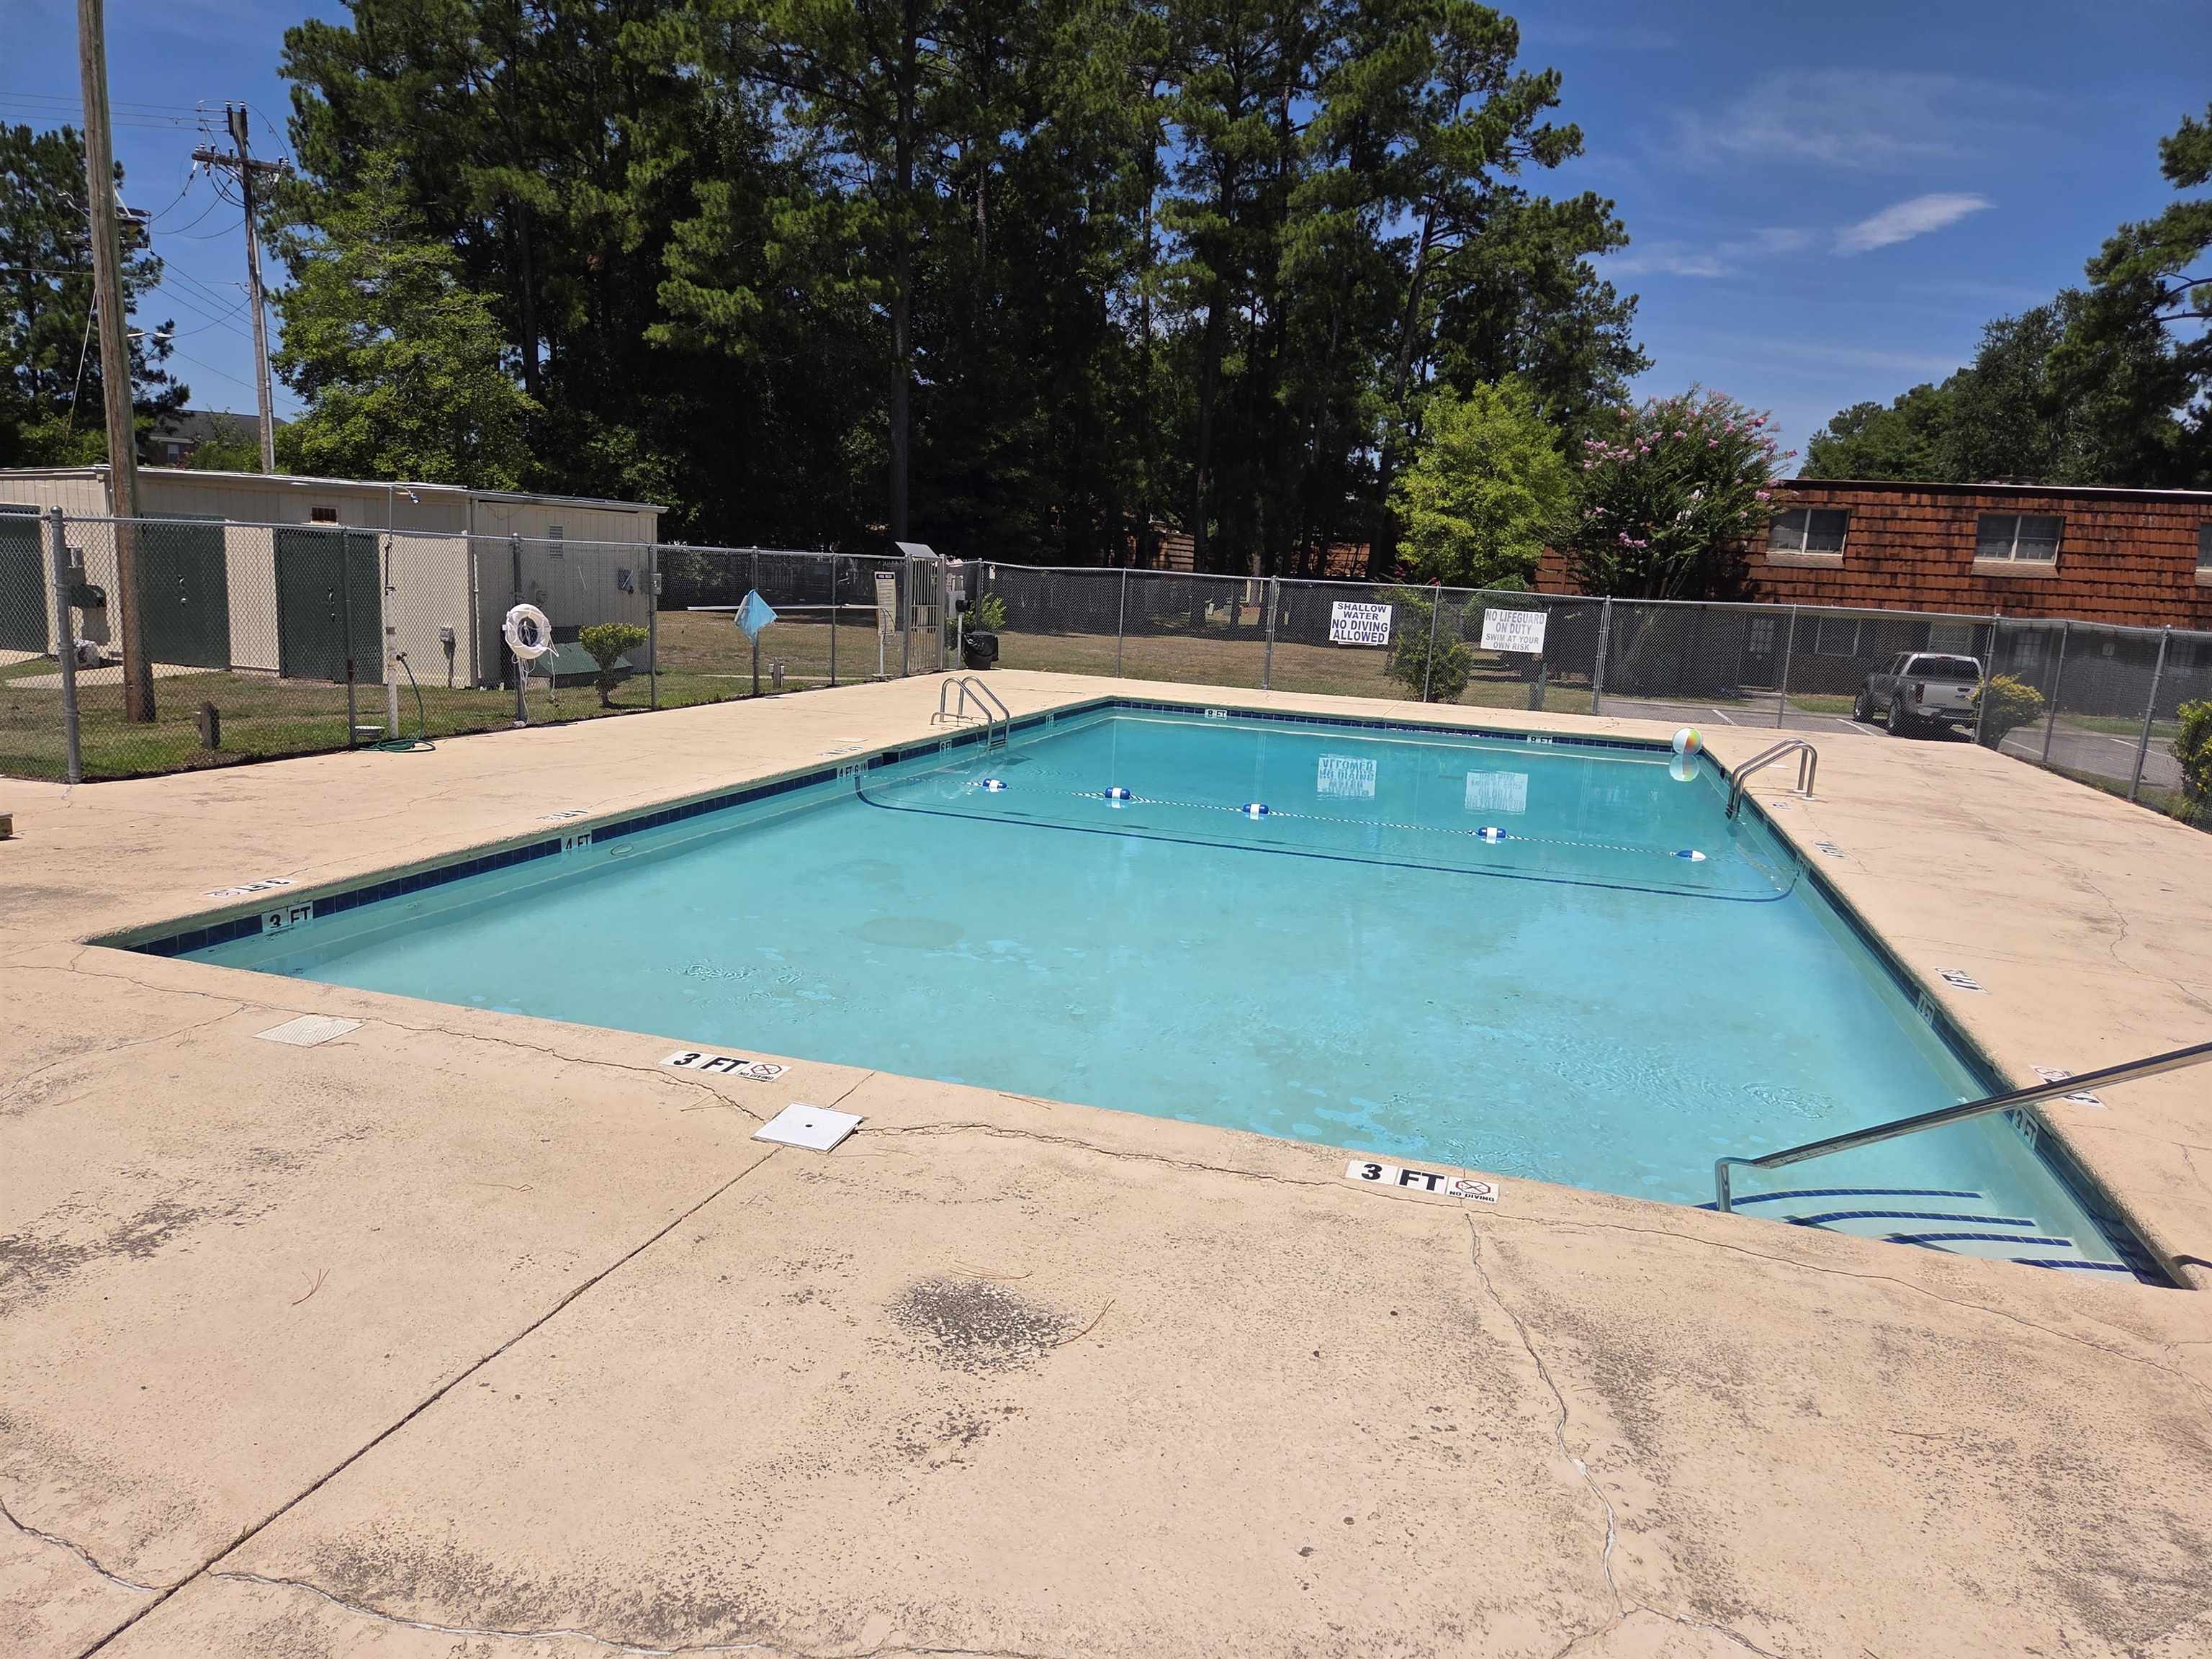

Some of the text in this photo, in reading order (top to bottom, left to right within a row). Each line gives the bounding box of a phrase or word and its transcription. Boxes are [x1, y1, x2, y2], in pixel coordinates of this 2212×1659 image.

[1337, 603, 1386, 613] SHALLOW
[1344, 611, 1378, 620] WATER
[1485, 610, 1545, 624] NO LIFEGUARD
[1332, 619, 1388, 632] NO DIVING
[1496, 622, 1532, 634] ON DUTY
[1333, 630, 1385, 643] ALLOWED
[1519, 636, 1539, 644] YOUR
[1512, 642, 1529, 651] RISK
[565, 834, 590, 850] 4 FT
[269, 905, 311, 929] 3 FT
[673, 1053, 750, 1073] 3 FT
[1361, 1164, 1445, 1192] 3 FT
[1465, 1193, 1495, 1202] DIVING
